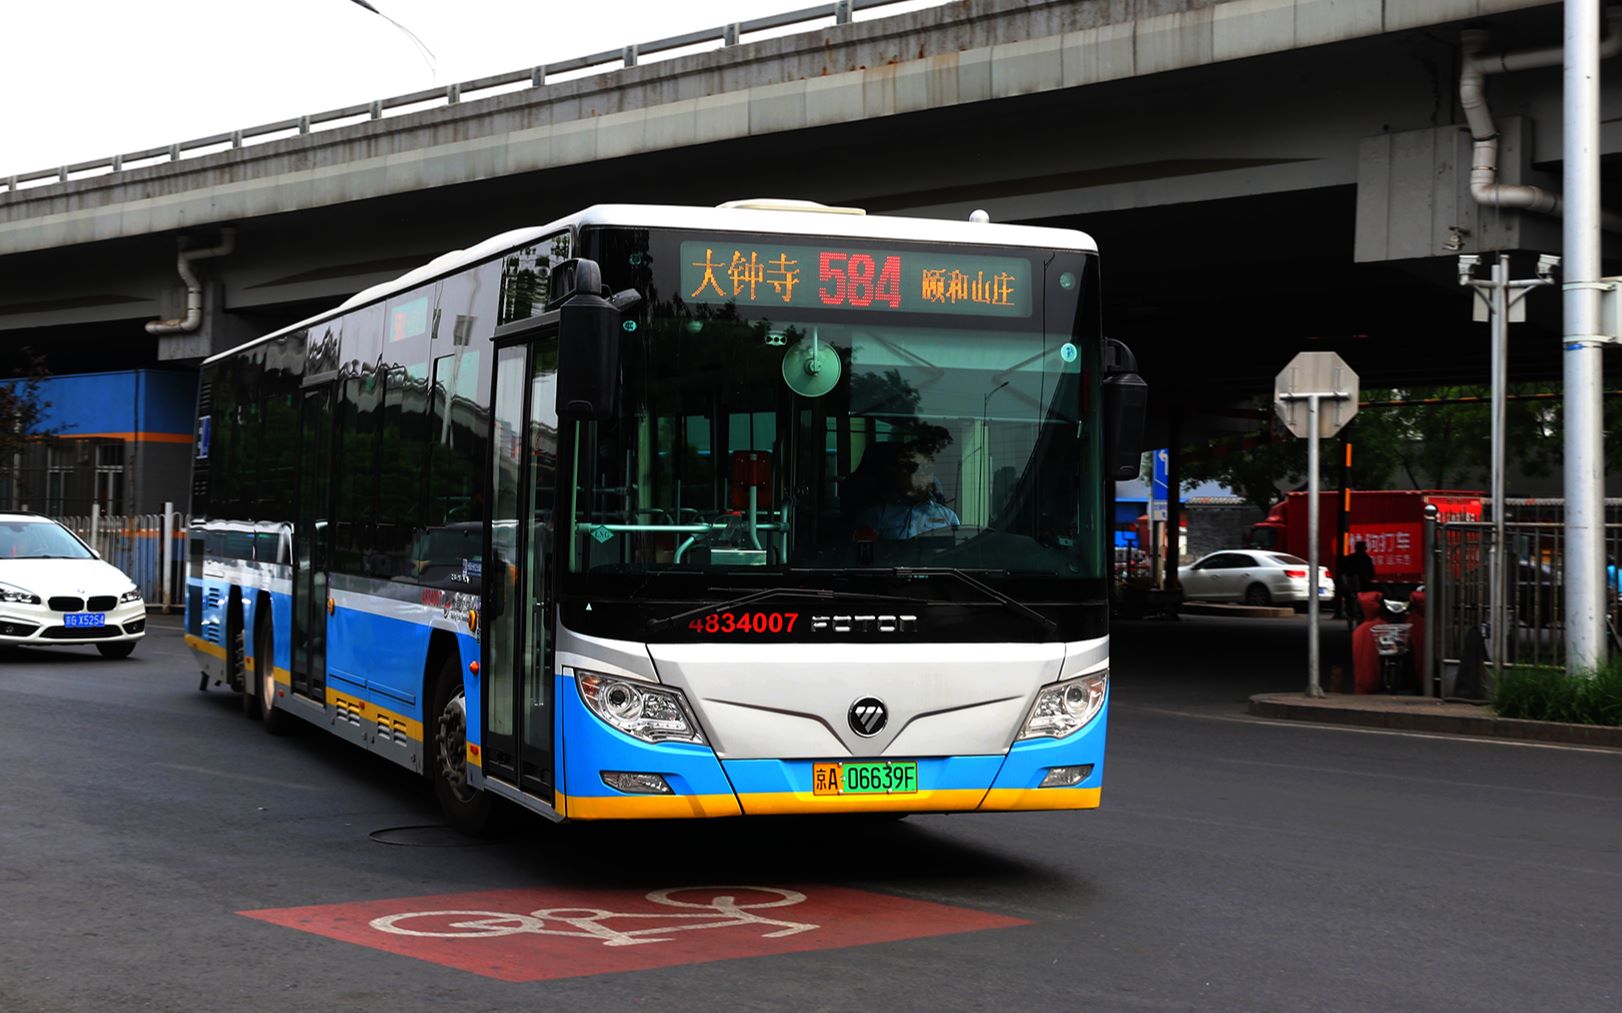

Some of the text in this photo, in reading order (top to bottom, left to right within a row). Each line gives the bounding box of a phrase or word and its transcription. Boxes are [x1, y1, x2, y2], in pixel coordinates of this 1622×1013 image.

[691, 248, 1015, 308] 大钟寺 584 颐和山庄
[688, 612, 799, 634] 4834007
[810, 615, 918, 633] FOTON
[816, 766, 914, 791] 京A 06639F
